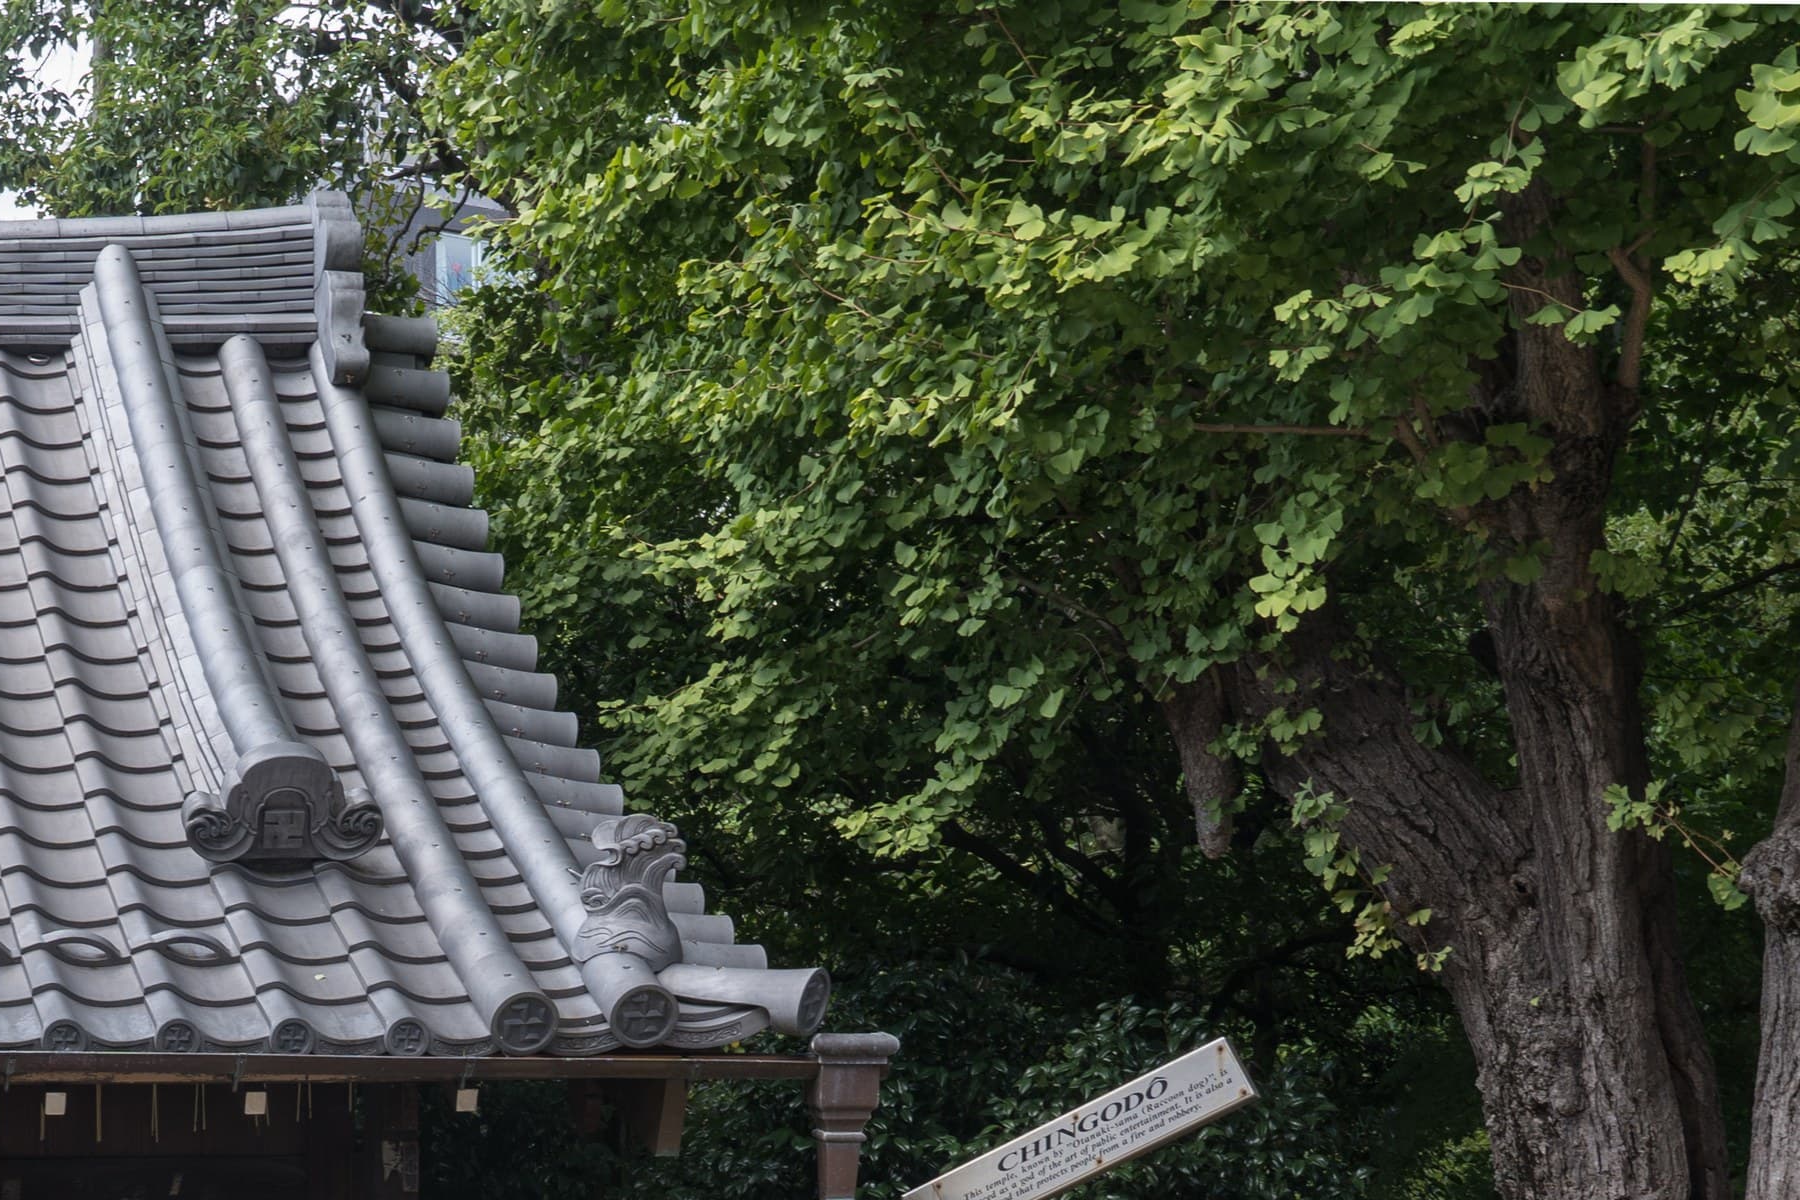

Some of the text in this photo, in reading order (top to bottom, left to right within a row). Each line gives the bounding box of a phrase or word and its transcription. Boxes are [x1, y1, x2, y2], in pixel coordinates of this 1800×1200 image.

[985, 1172, 1018, 1191] temple,
[1021, 1156, 1050, 1173] known
[1053, 1148, 1064, 1159] by
[1141, 1090, 1185, 1115] (Raccoon
[1220, 1068, 1228, 1078] is
[997, 1076, 1168, 1172] CHINGODÔ
[1000, 1186, 1009, 1195] as
[1020, 1173, 1035, 1187] god
[1038, 1165, 1047, 1176] of
[1048, 1158, 1062, 1171] the
[1065, 1152, 1078, 1163] art
[1080, 1145, 1089, 1156] of
[1091, 1133, 1116, 1151] public
[1184, 1095, 1192, 1105] It
[1195, 1091, 1203, 1100] is
[1205, 1081, 1224, 1095] also
[1016, 1184, 1034, 1197] that
[1036, 1168, 1068, 1189] protects
[1070, 1154, 1096, 1172] people
[1097, 1142, 1120, 1158] from
[1130, 1130, 1145, 1143] fire
[1148, 1121, 1165, 1132] and
